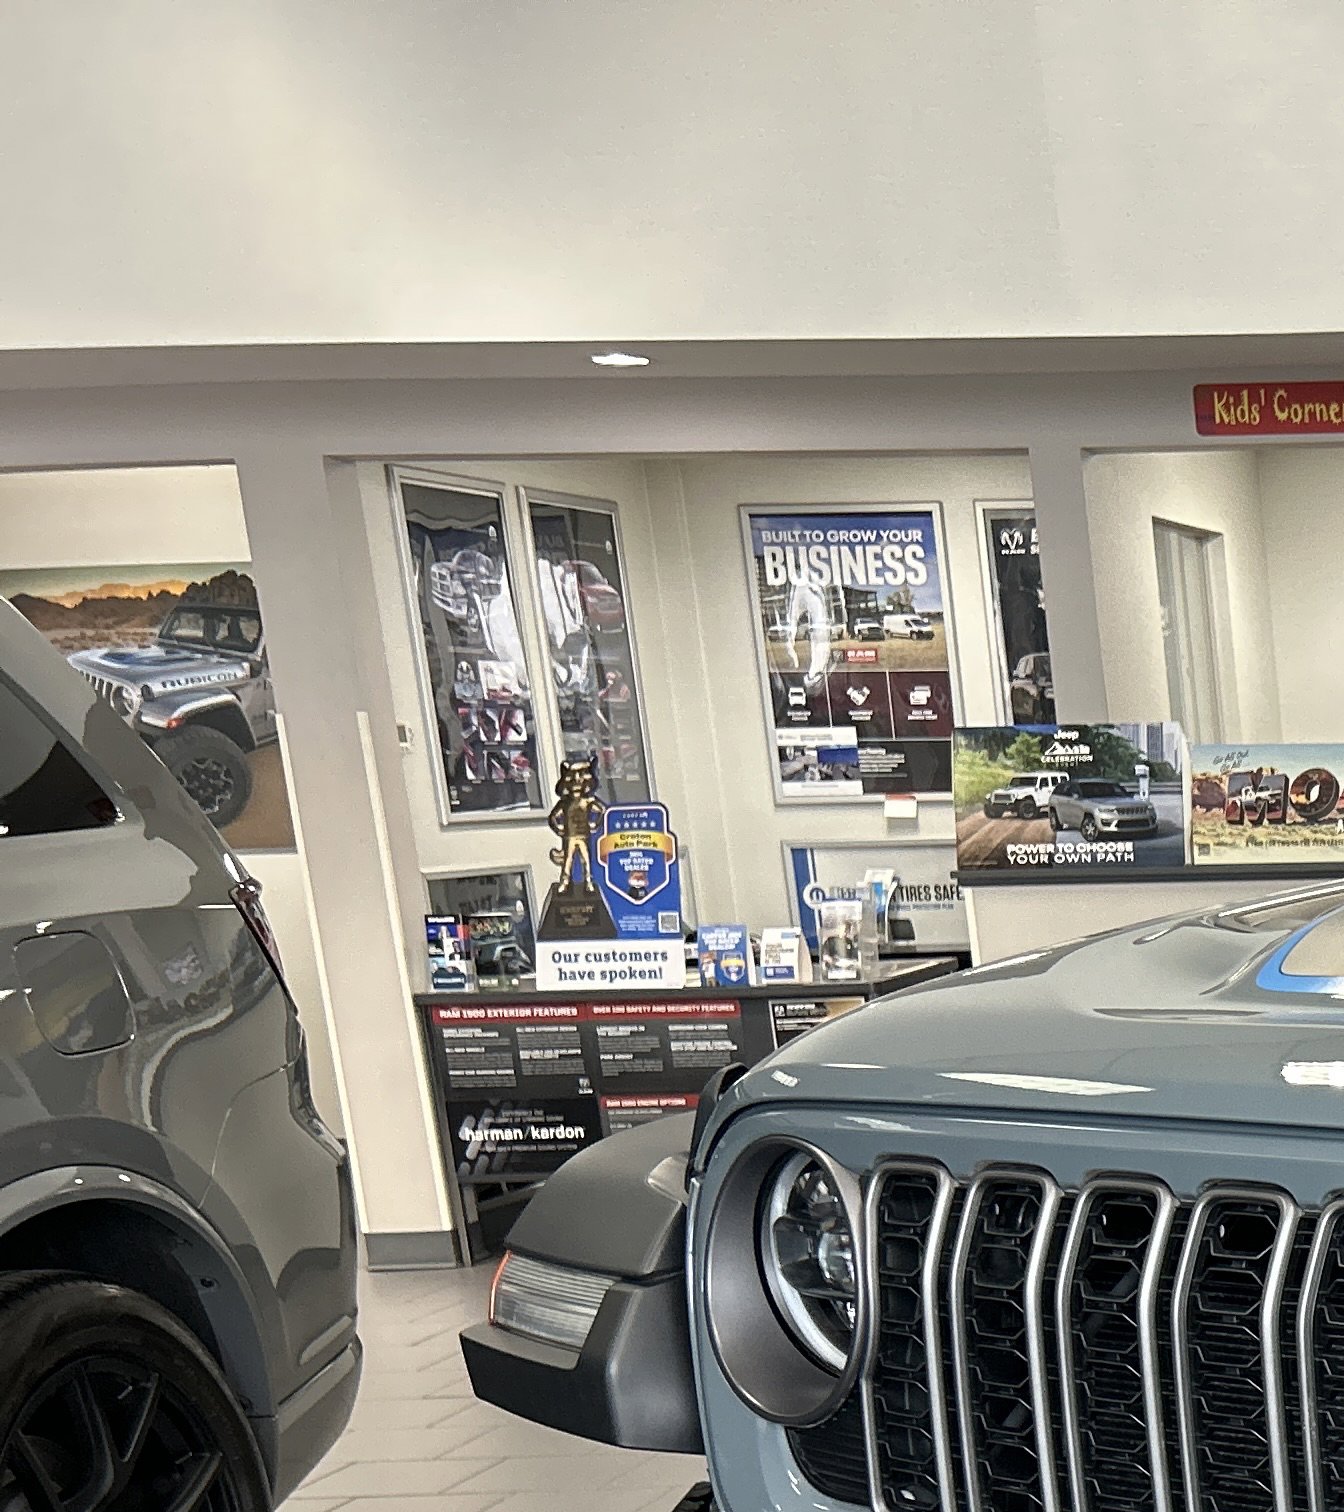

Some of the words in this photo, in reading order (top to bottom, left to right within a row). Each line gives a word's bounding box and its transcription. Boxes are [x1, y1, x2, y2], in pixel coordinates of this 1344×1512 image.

[1213, 388, 1264, 425] Kids'
[761, 530, 800, 544] BUILT
[804, 529, 824, 543] TO
[827, 529, 875, 543] GROW
[880, 529, 923, 543] YOUR
[763, 545, 928, 587] BUSINESS
[1007, 842, 1055, 855] POWER
[1058, 842, 1074, 853] TO
[1076, 841, 1134, 853] CHOOSE
[1008, 854, 1049, 865] YOUR
[1054, 853, 1091, 864] OWN
[1097, 852, 1135, 863] PATH
[899, 884, 931, 903] TIRES
[552, 950, 582, 964] Our
[585, 950, 668, 964] customers
[558, 967, 595, 982] have
[600, 967, 663, 983] spoken!
[487, 1007, 532, 1018] EXTERIOR
[534, 1006, 578, 1017] FEATURES
[464, 1124, 585, 1141] harman/kardon
